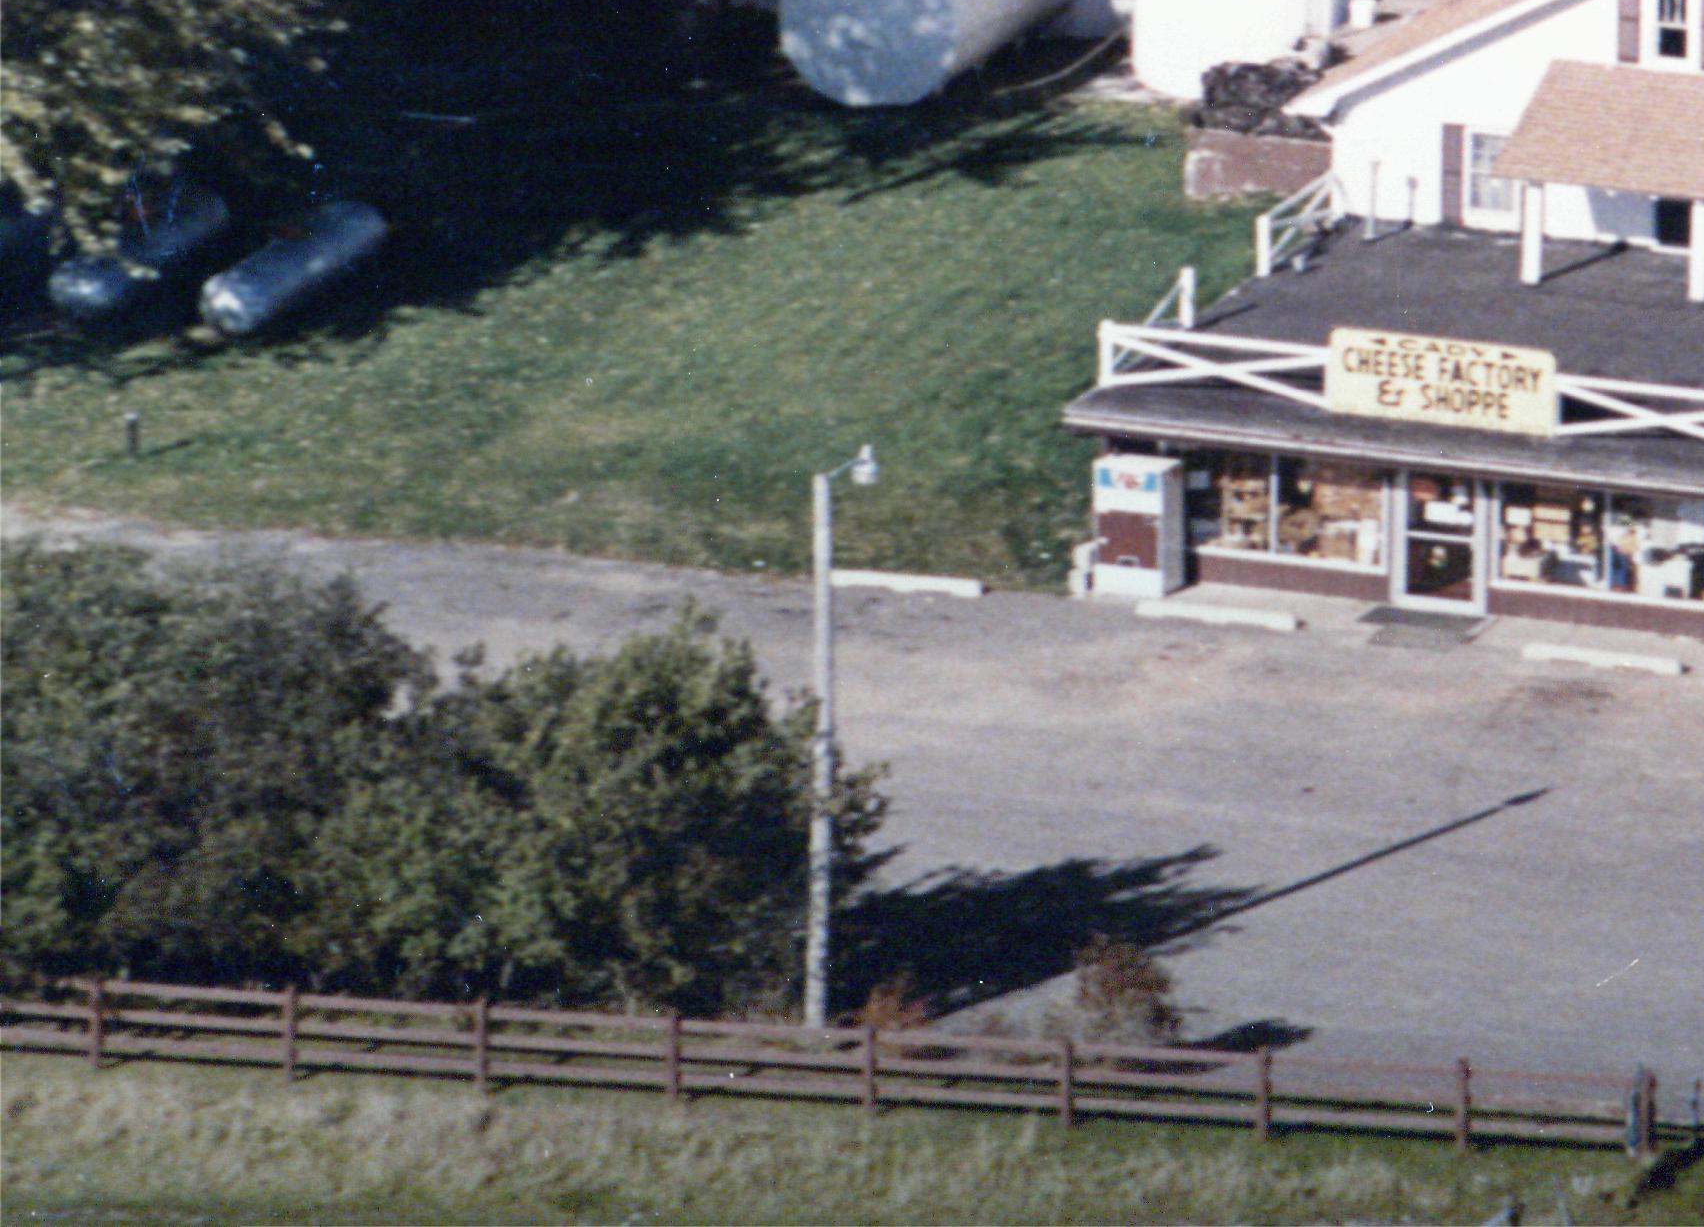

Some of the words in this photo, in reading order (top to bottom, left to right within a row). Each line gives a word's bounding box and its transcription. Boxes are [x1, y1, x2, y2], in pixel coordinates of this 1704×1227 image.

[1398, 339, 1486, 357] CADY
[1343, 347, 1425, 380] CHEESE
[1438, 357, 1543, 394] FACTORY
[1376, 380, 1406, 407] &
[1420, 384, 1509, 419] SHOPPE
